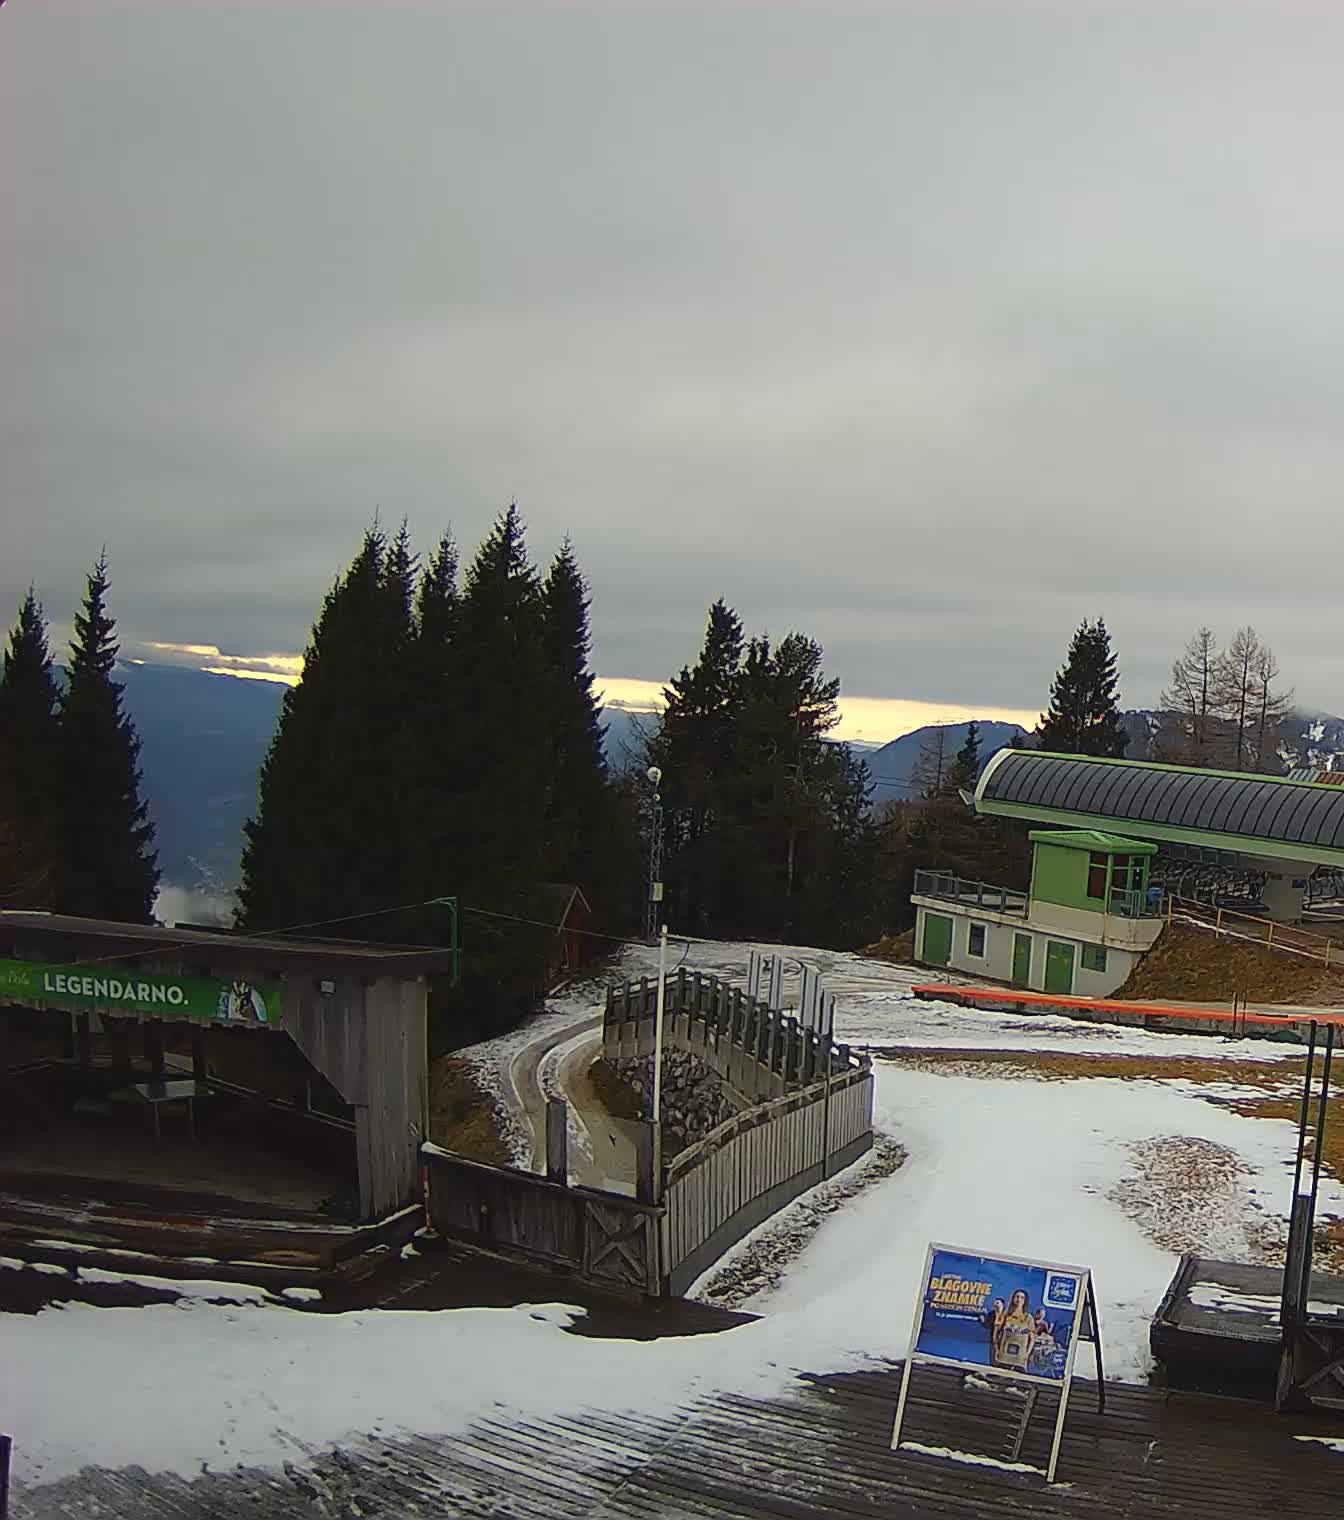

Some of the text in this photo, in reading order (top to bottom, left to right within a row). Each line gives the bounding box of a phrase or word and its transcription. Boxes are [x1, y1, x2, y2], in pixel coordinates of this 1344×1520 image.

[43, 972, 189, 1006] LEGENDARNO.
[930, 1278, 992, 1295] BLAGOVNE
[933, 1291, 985, 1306] ZNAMKE
